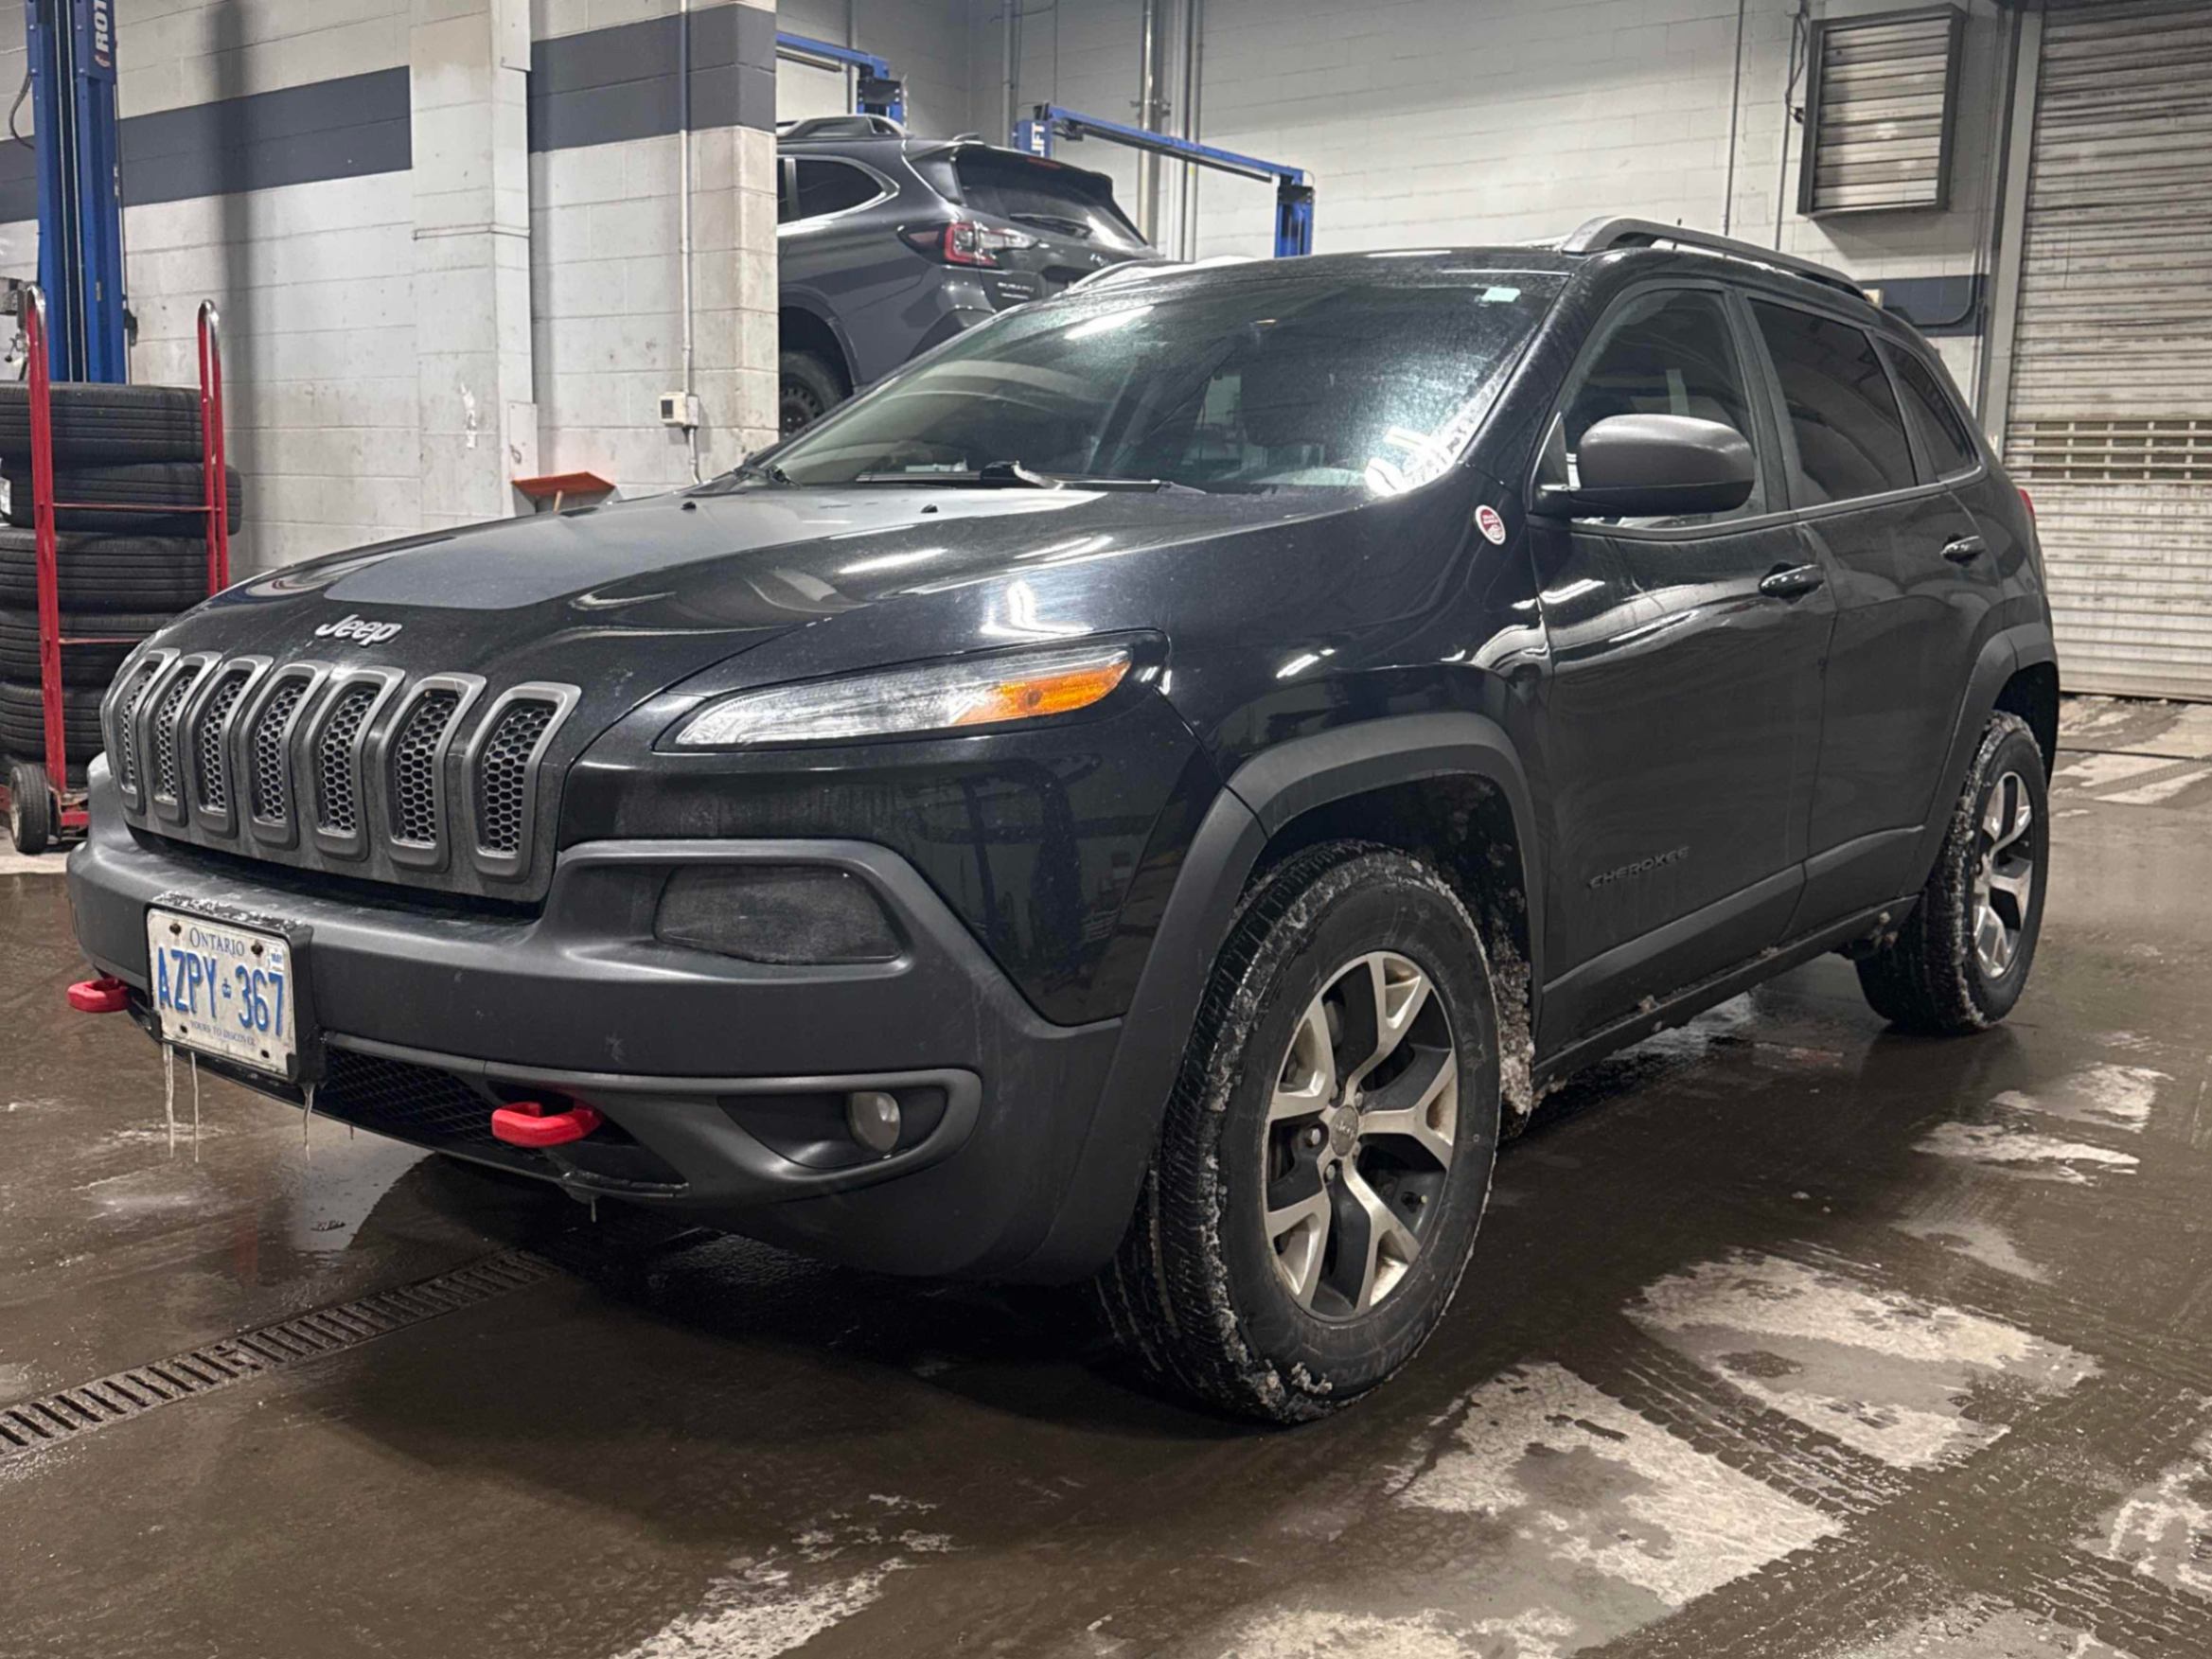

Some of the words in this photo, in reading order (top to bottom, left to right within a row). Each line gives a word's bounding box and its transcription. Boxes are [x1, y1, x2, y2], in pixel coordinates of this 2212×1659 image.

[314, 613, 402, 645] Jeep
[1590, 845, 1690, 889] CHEROKEE
[157, 946, 218, 1019] AZPY
[235, 964, 284, 1037] 367
[213, 1026, 222, 1037] TO
